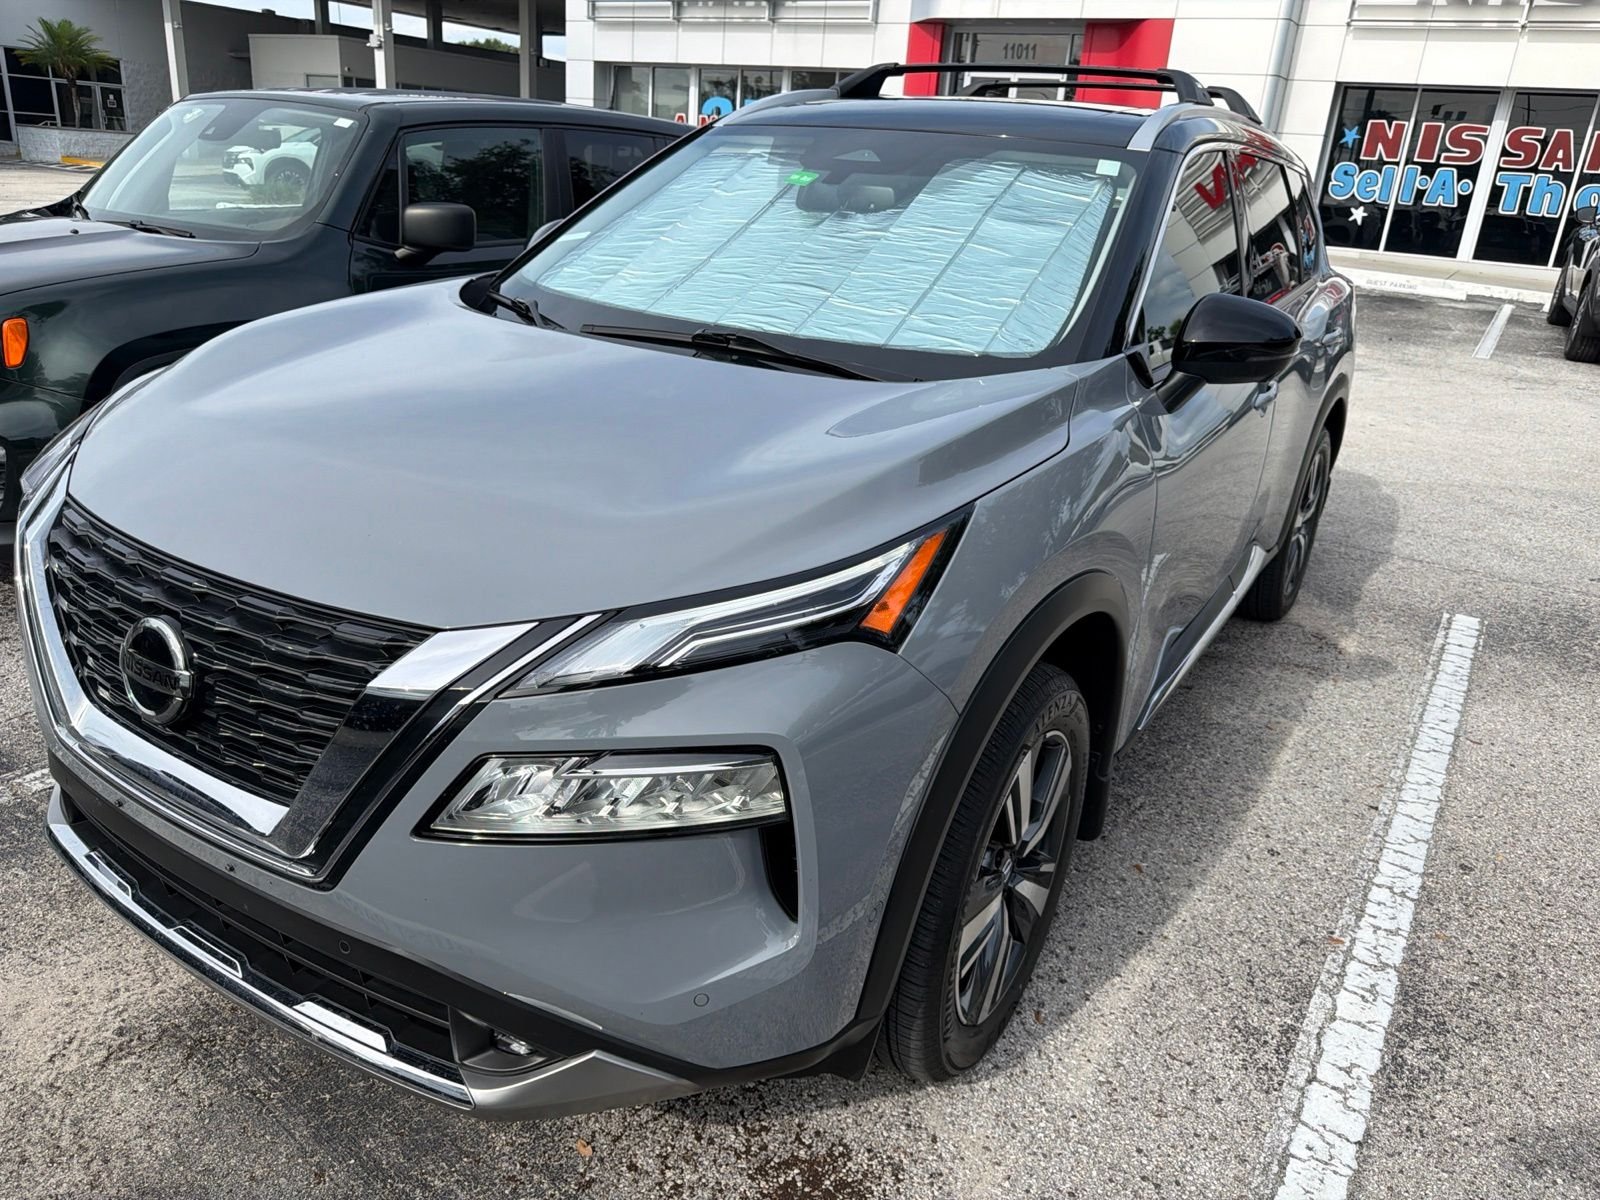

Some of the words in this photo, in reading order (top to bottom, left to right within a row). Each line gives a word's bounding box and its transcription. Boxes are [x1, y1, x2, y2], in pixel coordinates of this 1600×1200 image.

[1003, 42, 1037, 60] 11011
[1366, 279, 1387, 287] GUEST
[1390, 281, 1418, 290] PARKING
[125, 654, 178, 690] NISSAN
